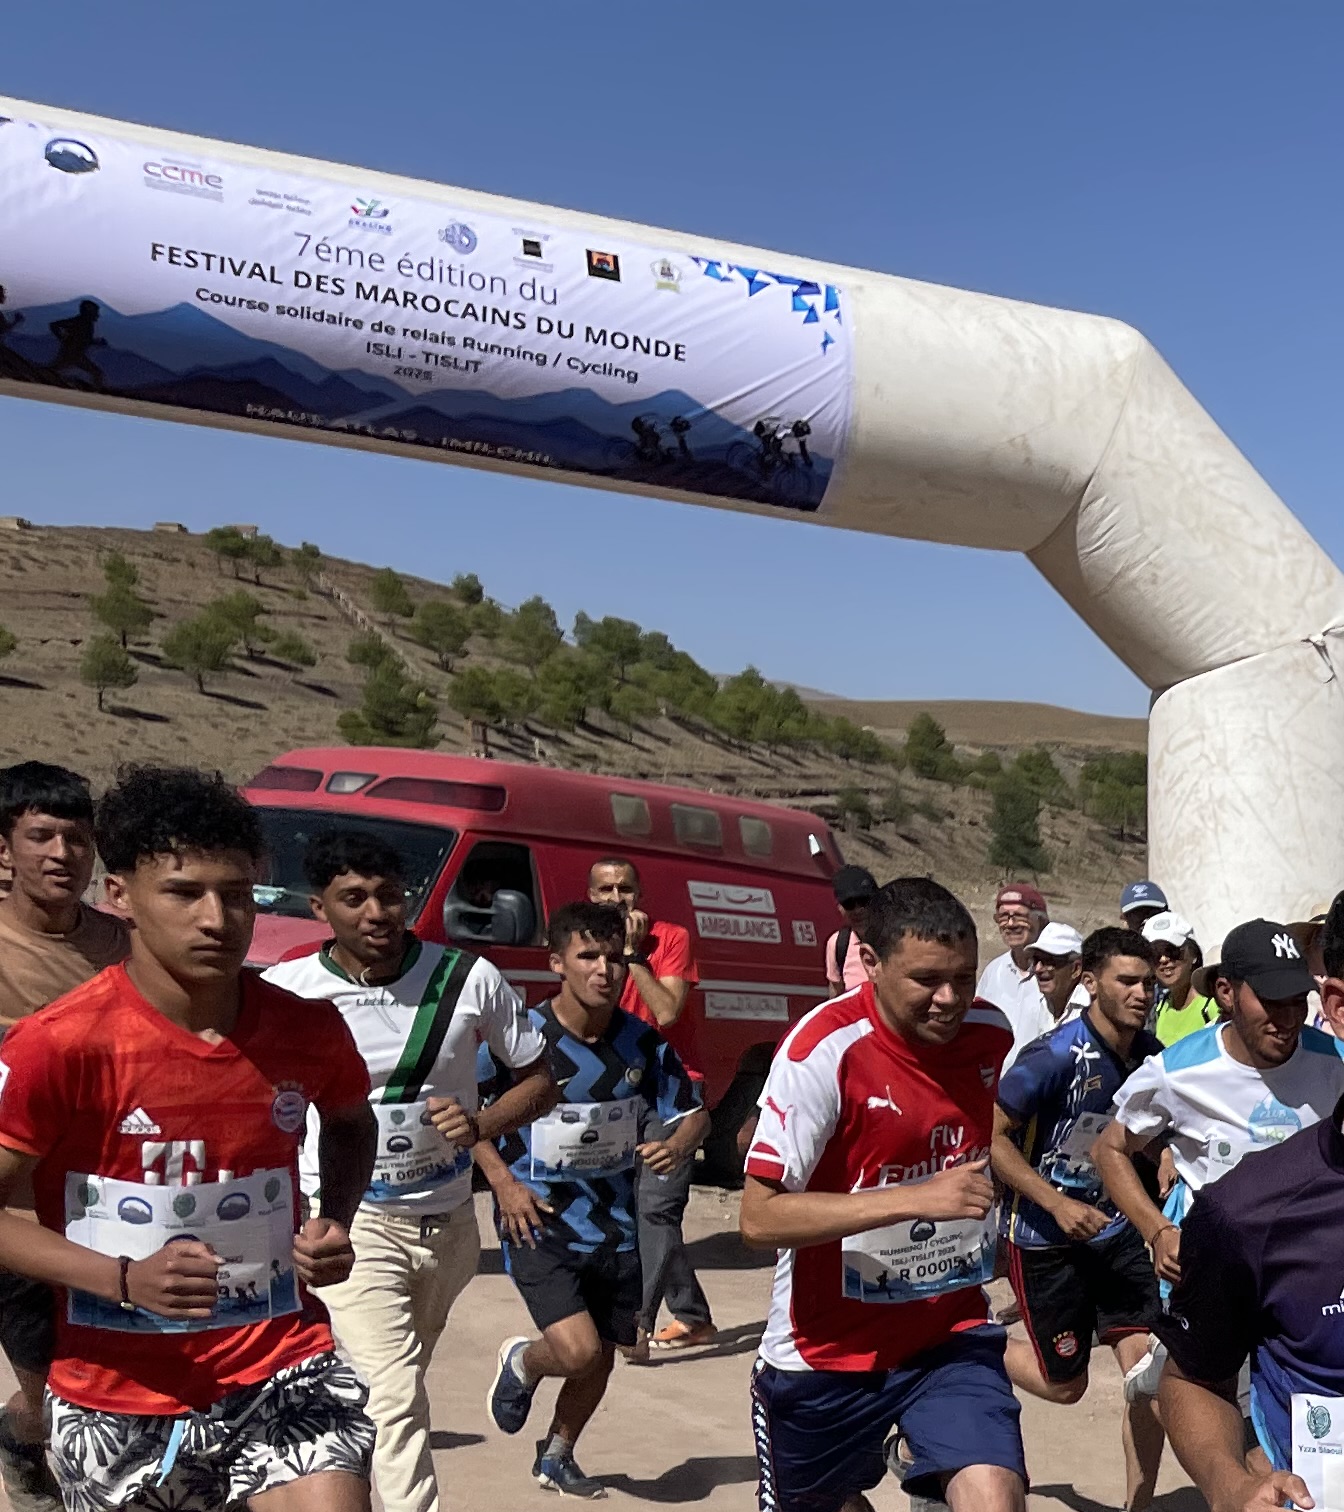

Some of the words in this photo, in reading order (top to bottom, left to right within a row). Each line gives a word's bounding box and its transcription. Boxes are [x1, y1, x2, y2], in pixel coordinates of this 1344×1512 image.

[143, 161, 224, 190] ccme
[293, 231, 385, 272] 7éme
[397, 251, 507, 296] édition
[518, 276, 558, 306] du
[150, 241, 284, 286] FESTIVAL
[293, 269, 346, 297] DES
[355, 281, 527, 331] MAROCAINS
[536, 314, 575, 340] DU
[584, 324, 687, 362] MONDE
[195, 286, 270, 313] Course
[276, 300, 364, 331] solidaire
[370, 317, 397, 337] de
[402, 324, 456, 349] relais
[462, 335, 548, 368] Running
[566, 355, 640, 385] Cycling
[365, 340, 403, 361] ISLI
[421, 349, 482, 375] TISLIT
[701, 915, 778, 940] AMBULANCE
[930, 1124, 964, 1149] Fly
[900, 1268, 911, 1282] R
